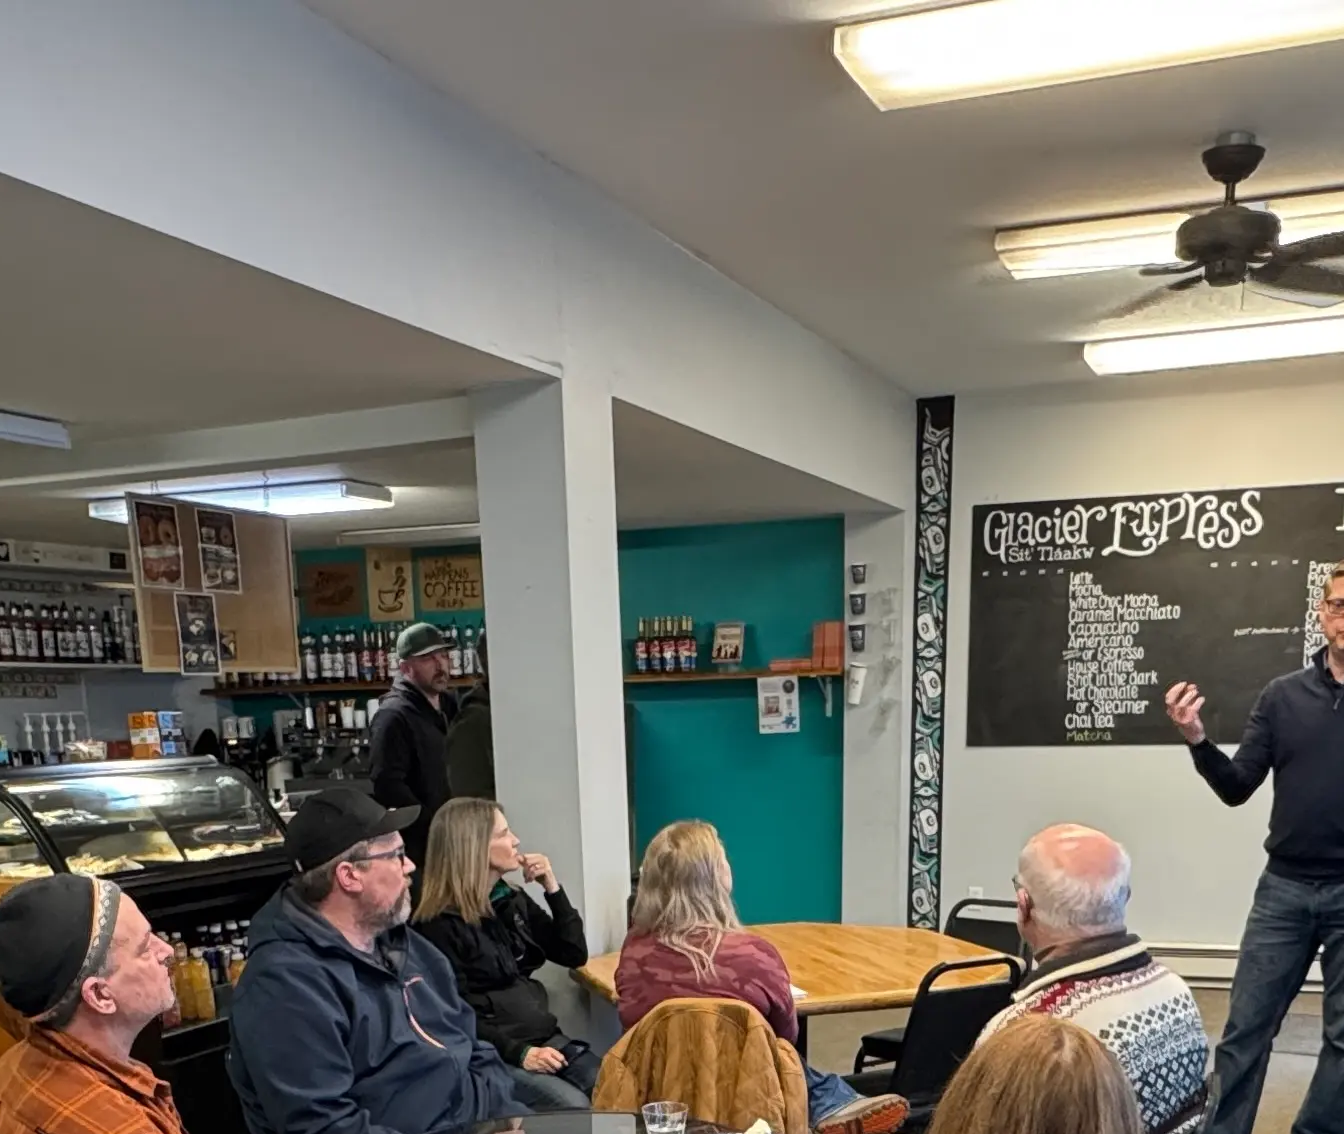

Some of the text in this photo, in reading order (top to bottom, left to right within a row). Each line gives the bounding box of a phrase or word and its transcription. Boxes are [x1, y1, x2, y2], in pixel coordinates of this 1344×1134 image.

[1070, 571, 1093, 584] Latte
[424, 580, 479, 598] COFFEE
[1069, 584, 1102, 597] Mocha
[1124, 593, 1158, 607] Mocha
[1068, 605, 1181, 622] Caramel Macchiato
[1068, 621, 1139, 636] Cappuccino
[1068, 634, 1133, 649] Americano
[1082, 651, 1094, 661] or
[1097, 647, 1145, 661] Espresso
[1068, 660, 1134, 673] House Coffee
[1067, 673, 1093, 687] Shot
[1129, 670, 1158, 685] dark
[1088, 685, 1139, 701] Chocolate
[1076, 700, 1149, 715] or Steamer
[1065, 714, 1091, 729] Chai
[1066, 730, 1112, 742] Matcha
